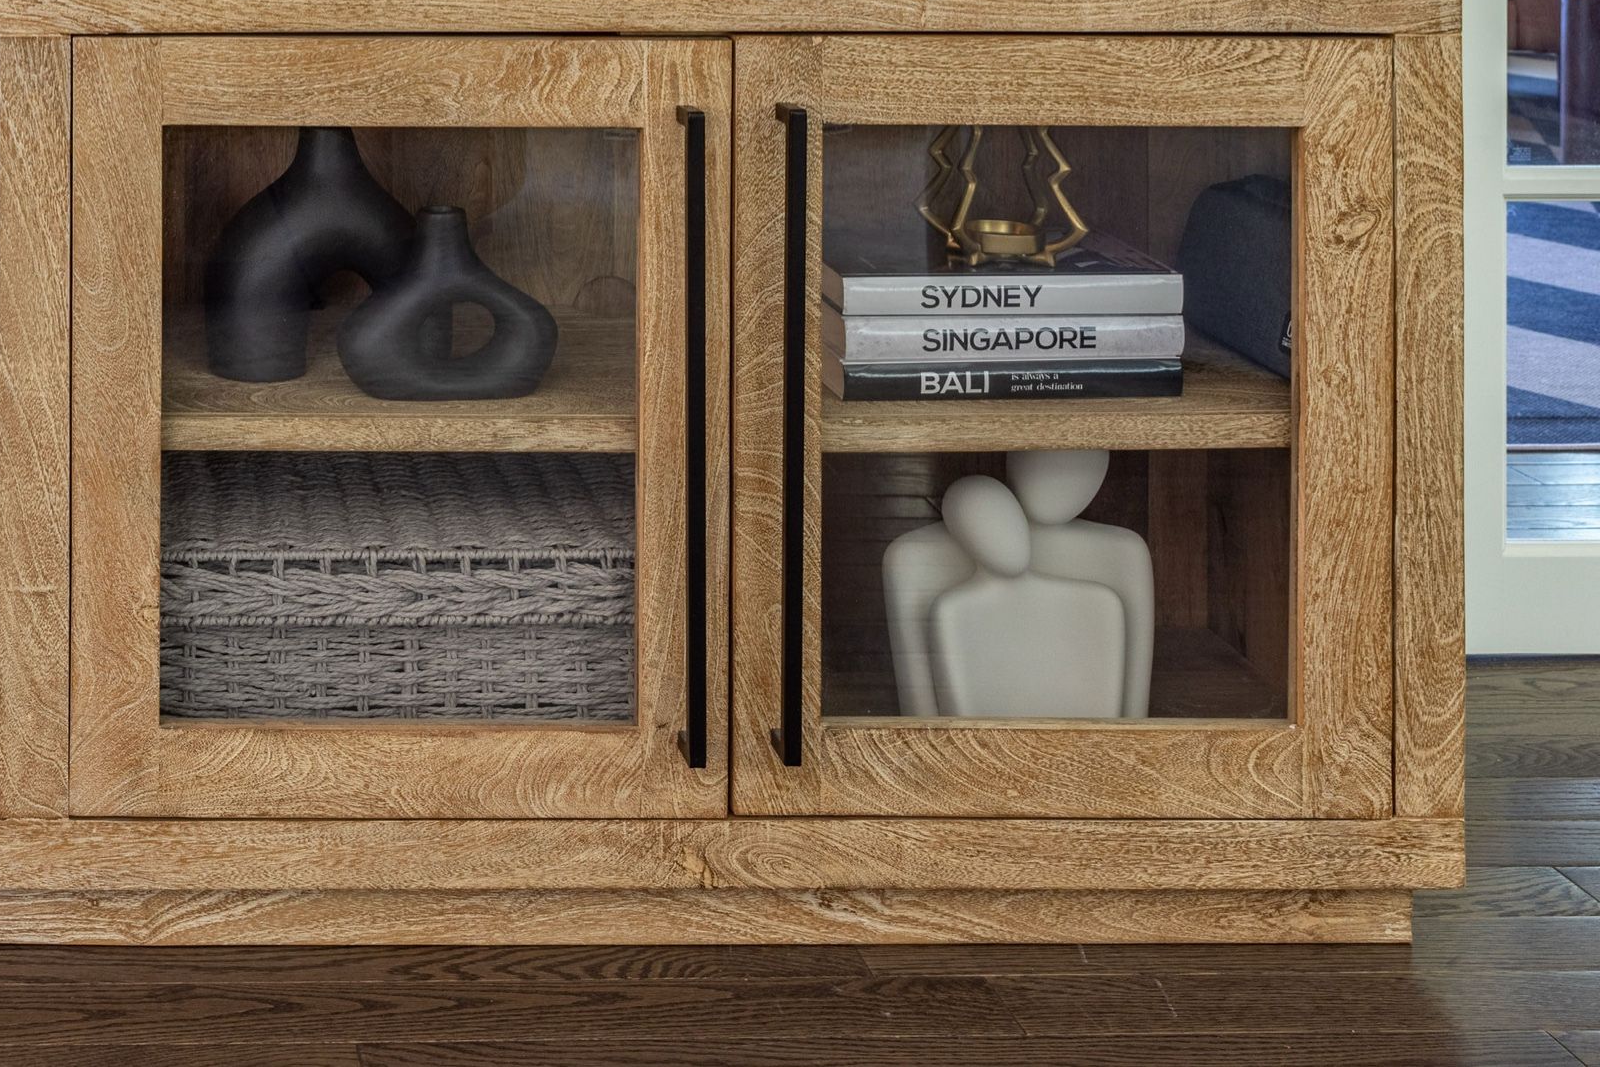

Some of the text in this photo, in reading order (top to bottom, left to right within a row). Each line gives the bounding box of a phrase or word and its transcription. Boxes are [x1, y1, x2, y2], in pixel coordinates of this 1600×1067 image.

[920, 284, 1043, 309] SYDNEY
[922, 326, 1097, 352] SINGAPORE
[919, 370, 990, 395] BALI
[1011, 371, 1059, 381] is always a
[1011, 381, 1083, 392] great destination
